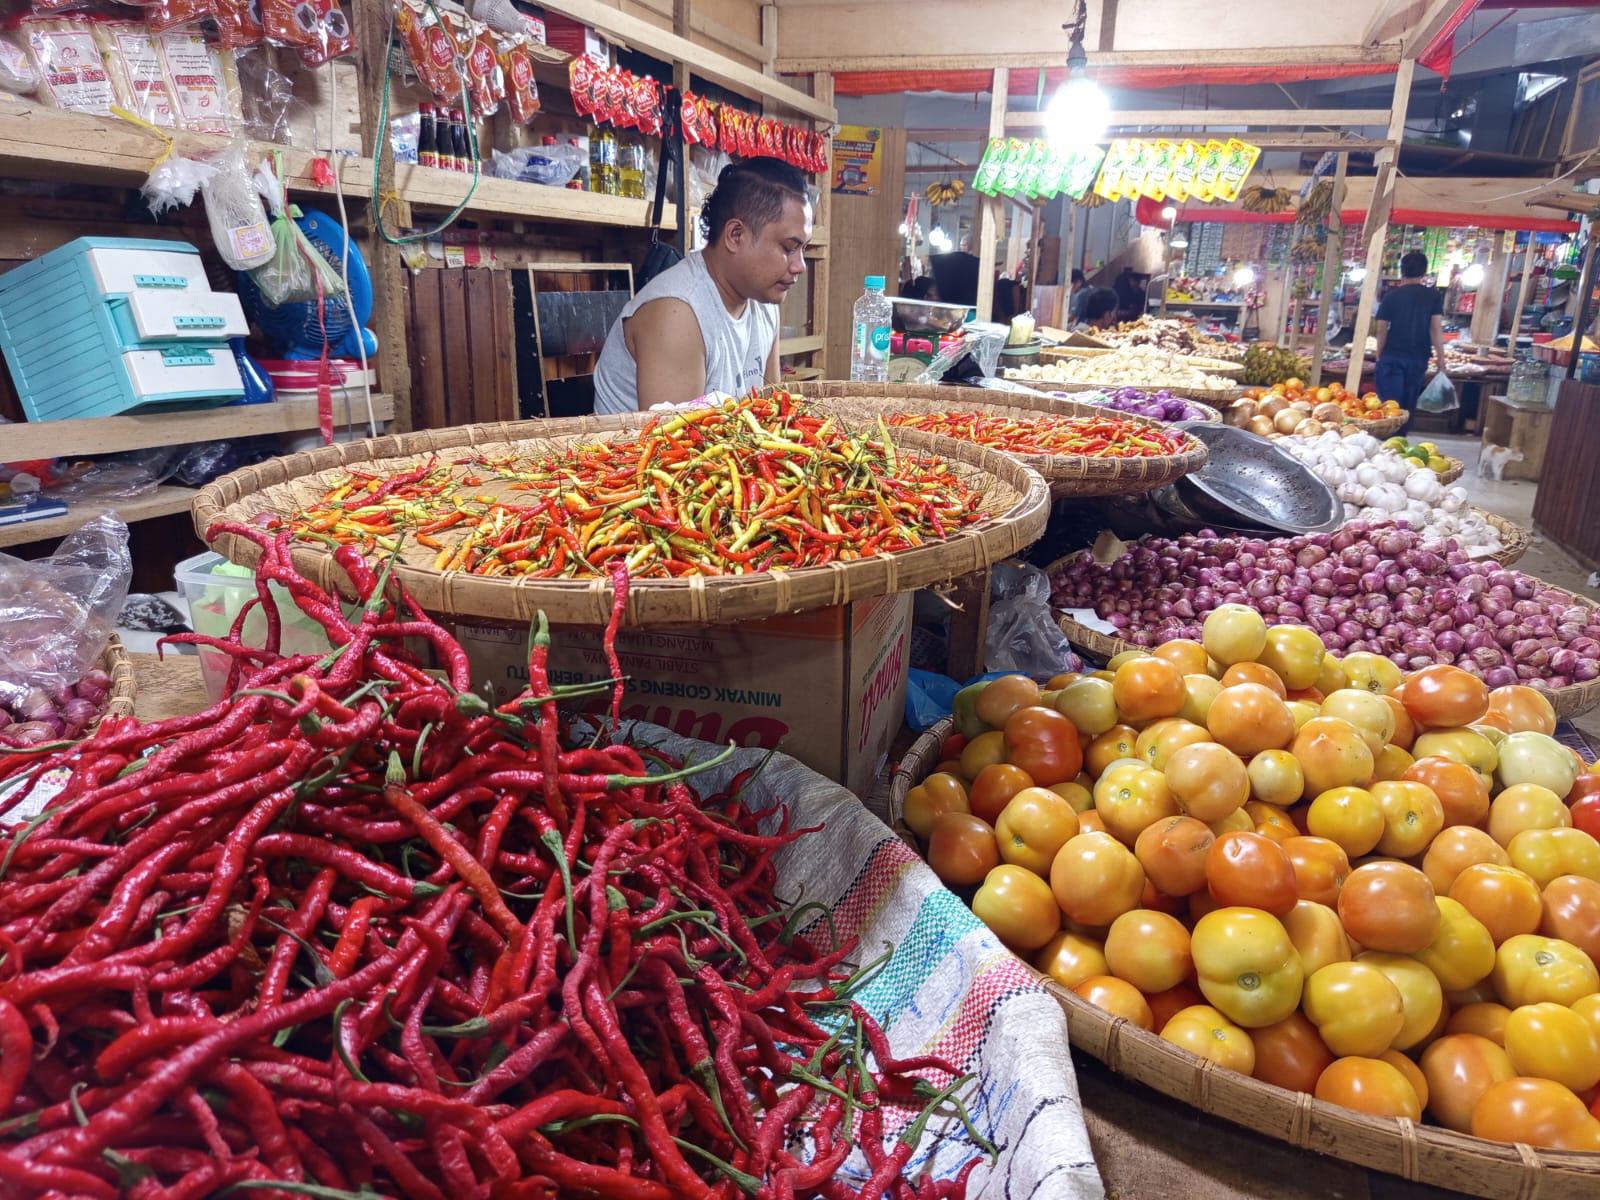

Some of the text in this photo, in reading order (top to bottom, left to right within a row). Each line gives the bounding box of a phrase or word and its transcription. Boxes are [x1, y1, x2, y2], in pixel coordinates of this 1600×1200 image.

[473, 48, 490, 65] ABC
[657, 635, 714, 652] MATANG
[583, 650, 698, 674] STABIL PANANYA
[506, 665, 583, 685] BERTU
[640, 680, 711, 700] GORENG
[715, 687, 782, 707] MINYAK
